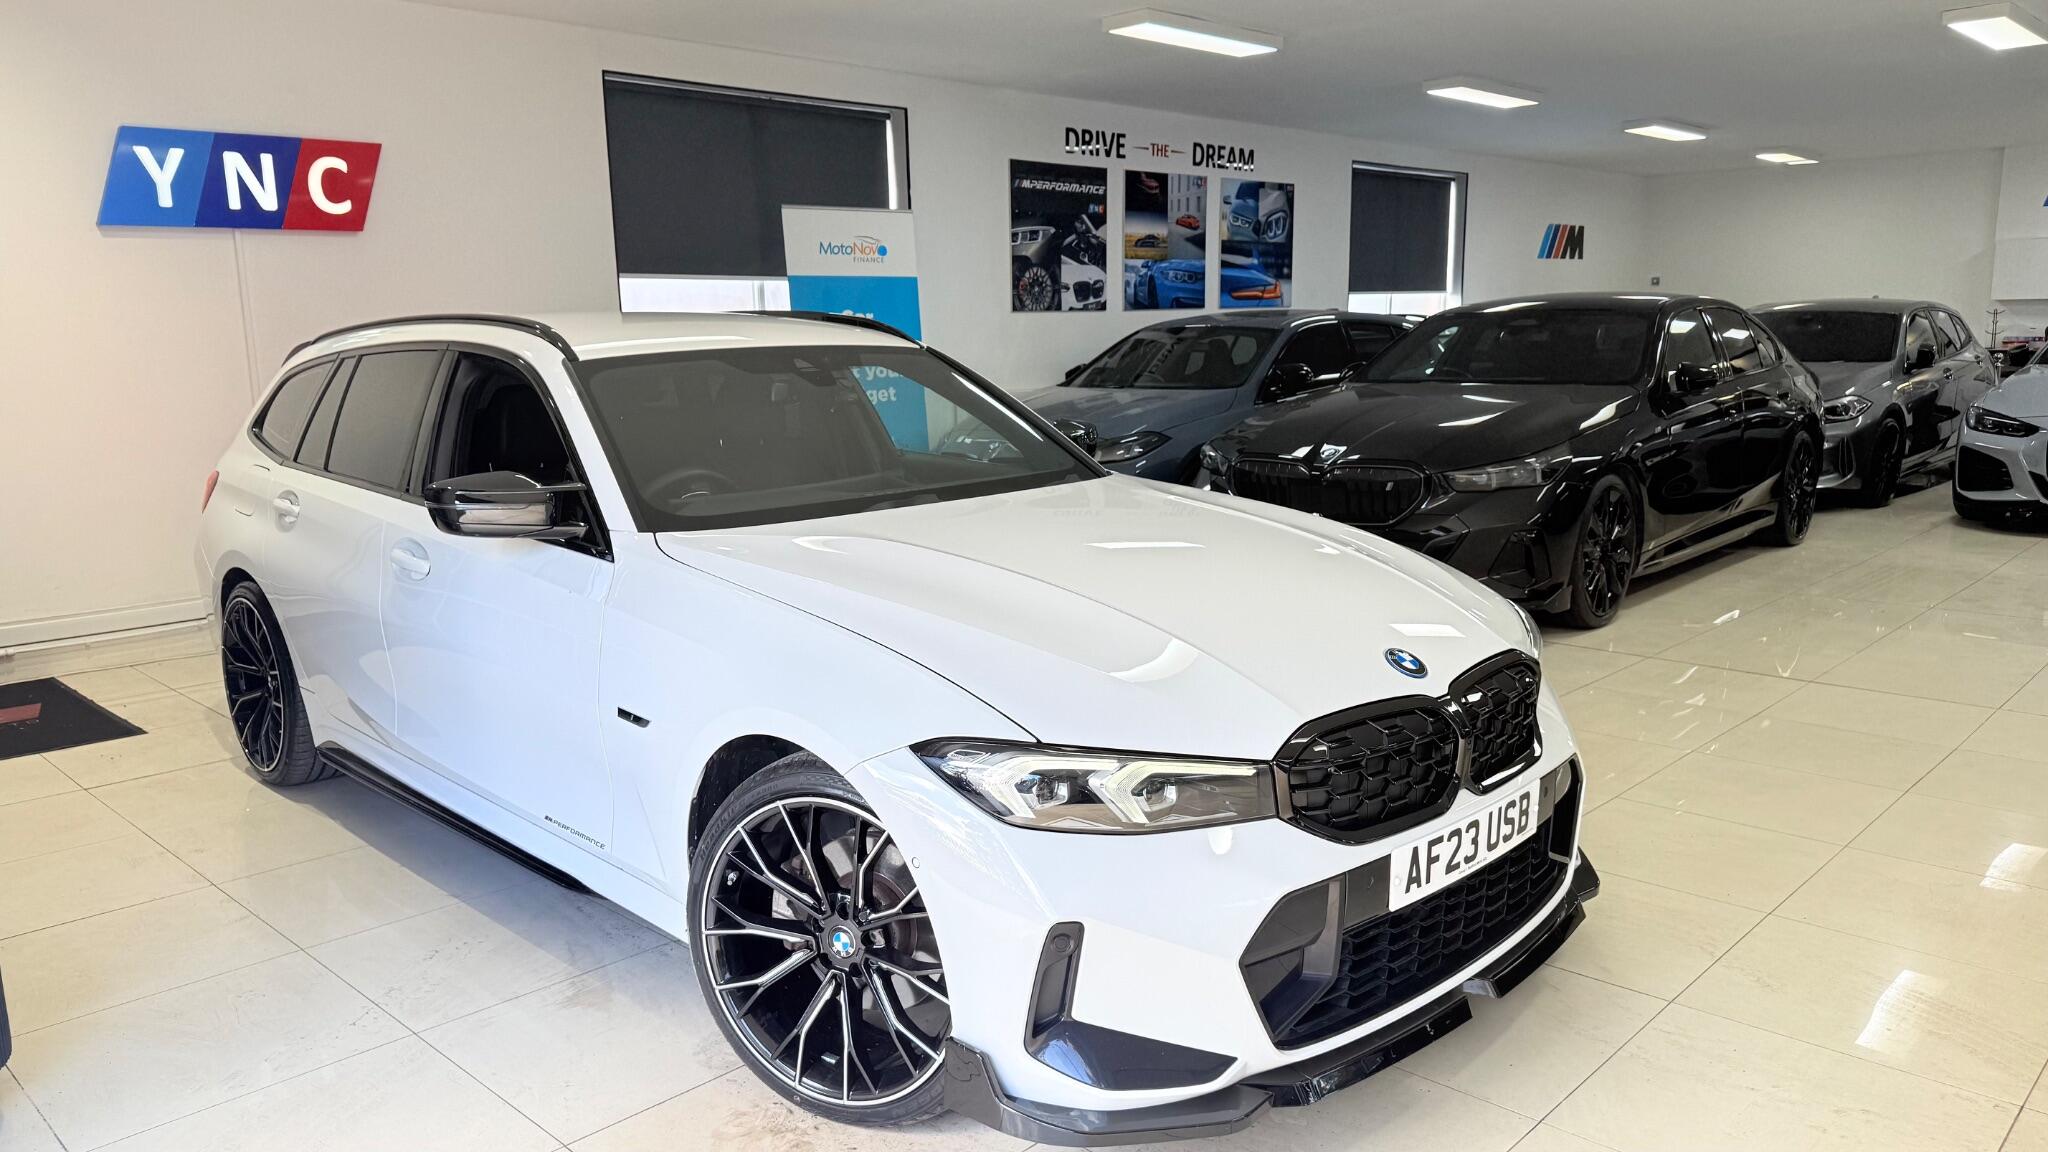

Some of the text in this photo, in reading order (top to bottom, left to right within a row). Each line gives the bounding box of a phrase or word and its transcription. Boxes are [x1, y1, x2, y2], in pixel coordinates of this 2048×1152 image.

[1065, 126, 1255, 172] DRIVE THE DREAM
[132, 145, 352, 215] YNC
[864, 366, 905, 381] you
[1404, 790, 1532, 895] AF23 USB
